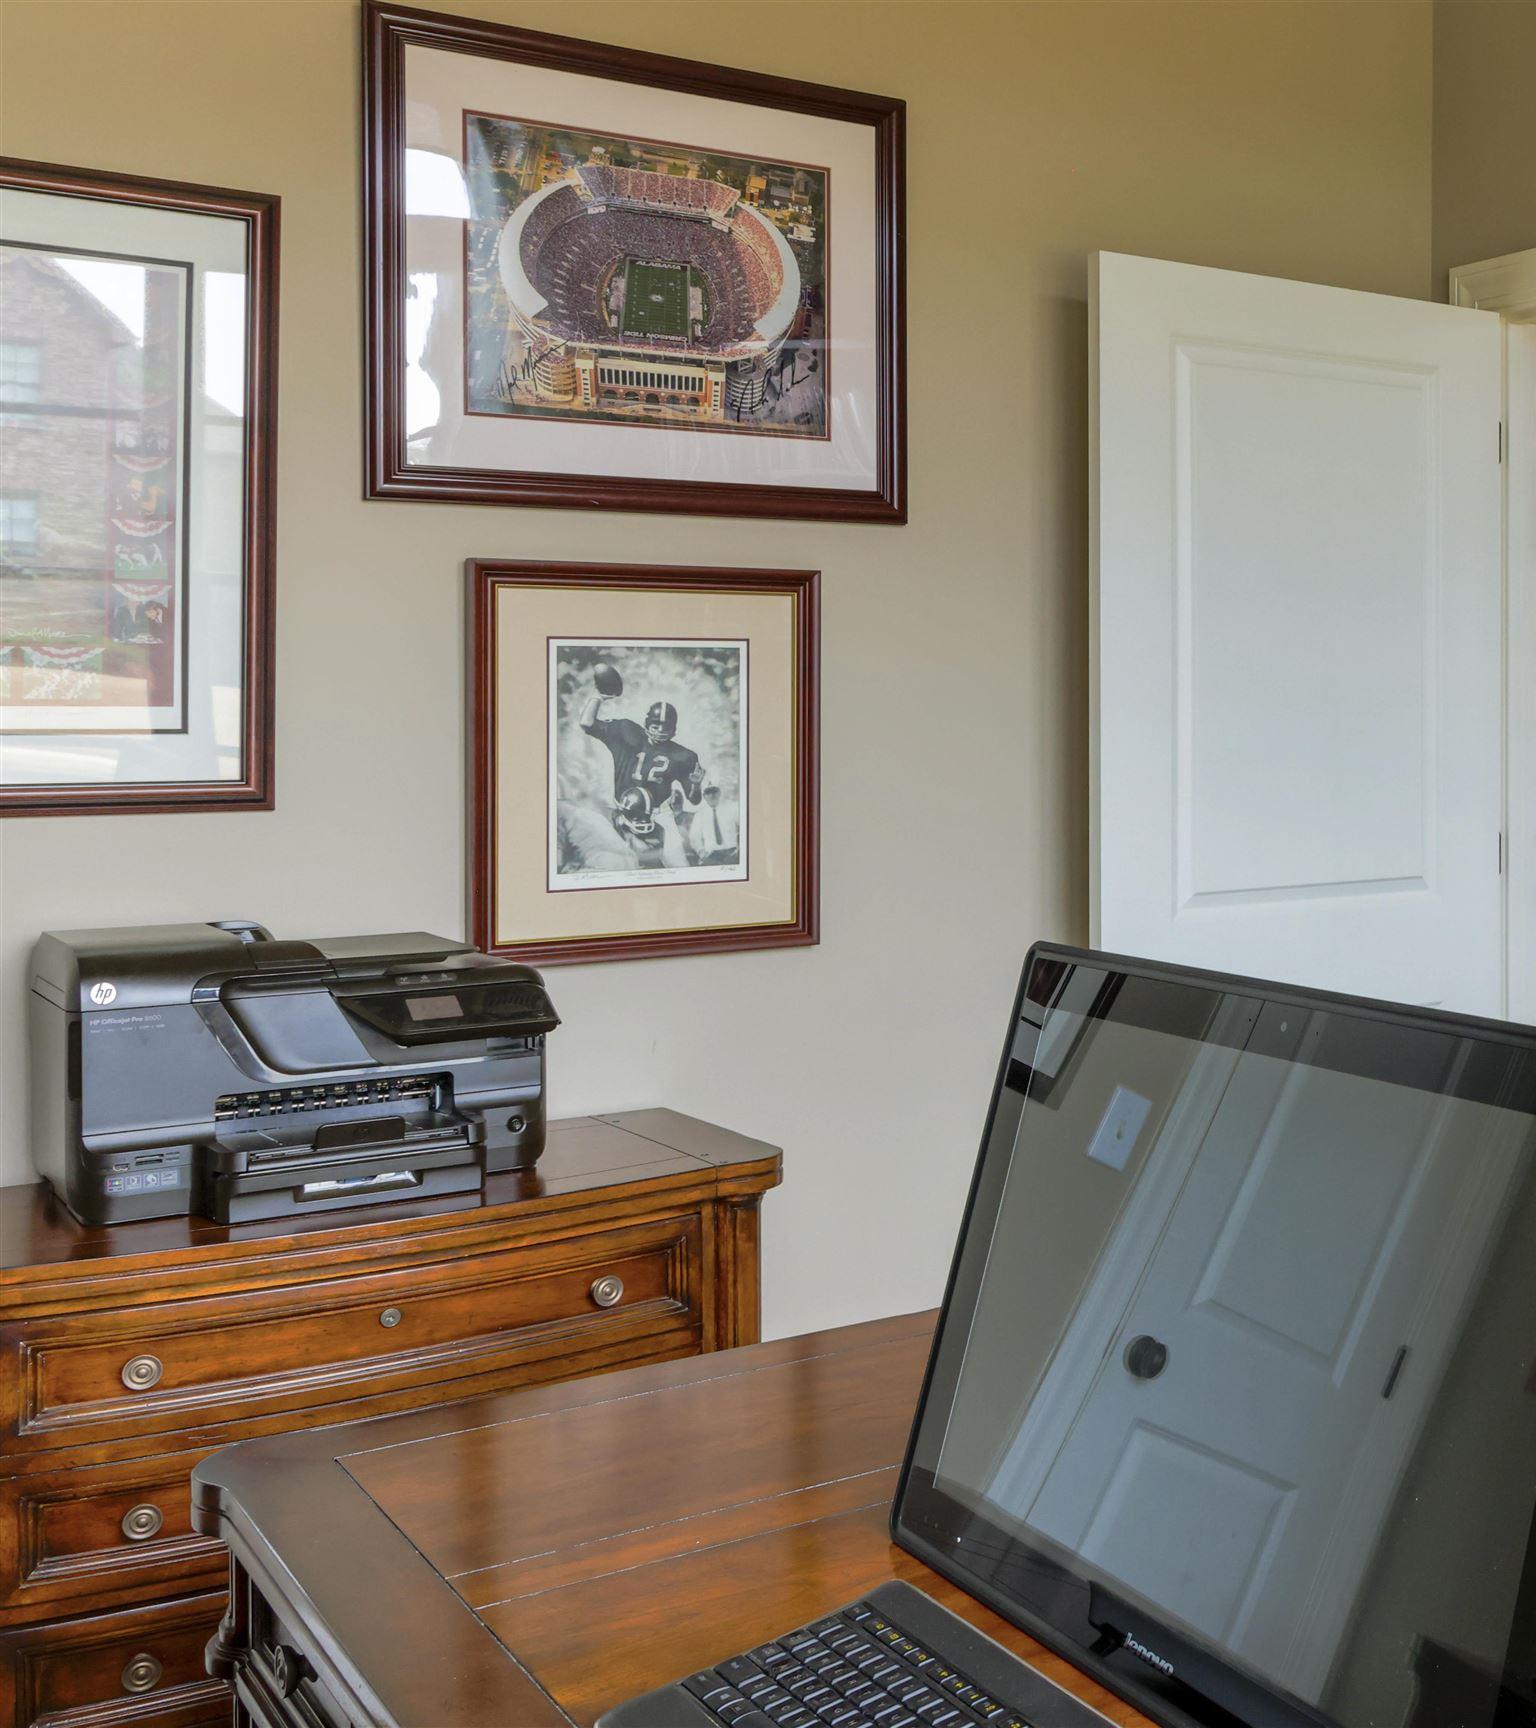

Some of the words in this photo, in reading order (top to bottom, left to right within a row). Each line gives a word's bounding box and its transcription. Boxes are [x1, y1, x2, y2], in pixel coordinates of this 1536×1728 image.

[631, 751, 671, 785] 12
[96, 983, 113, 1006] hp
[1124, 1631, 1175, 1677] lenovo
